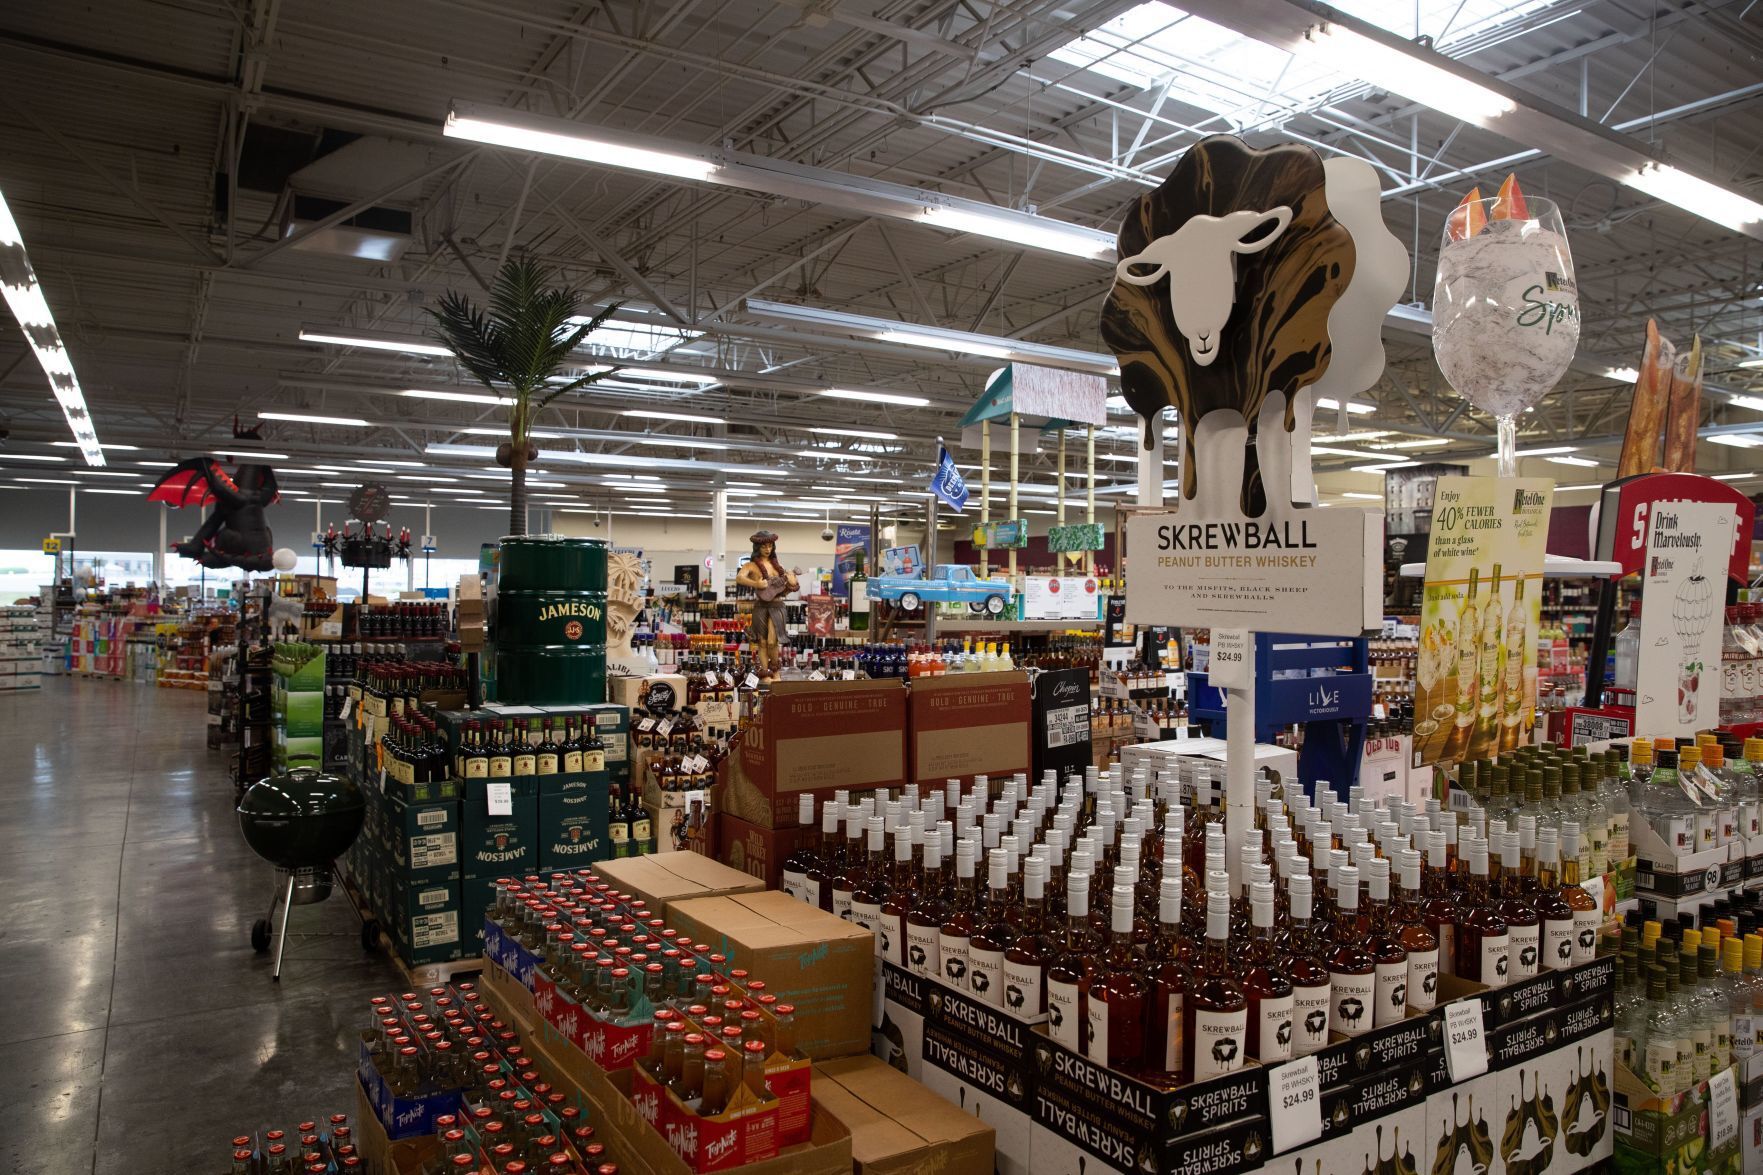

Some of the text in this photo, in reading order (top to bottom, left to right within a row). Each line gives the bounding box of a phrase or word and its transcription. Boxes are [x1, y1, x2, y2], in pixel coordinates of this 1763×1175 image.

[1440, 491, 1460, 502] Enjoy
[1437, 506, 1494, 530] 40% FEWER
[1464, 519, 1502, 530] CALORIES
[1655, 511, 1679, 530] Drink
[1157, 520, 1317, 550] SKREWBALL
[1435, 536, 1451, 545] than
[1457, 536, 1474, 546] glass
[1653, 531, 1702, 553] Marvelously.
[45, 542, 58, 550] 12
[1433, 548, 1441, 558] of
[1442, 548, 1460, 557] white
[1157, 555, 1317, 567] PEANUT BUTTER WHISKEY
[538, 603, 601, 622] JAMESON
[1217, 652, 1242, 662] $24.99
[1053, 680, 1081, 697] Chopin
[1309, 684, 1339, 706] LIVE
[791, 698, 888, 713] BOLD GENUINE TRUE
[930, 692, 1015, 707] BOLD GENUINE TRUE
[745, 727, 765, 749] 101
[1366, 740, 1382, 756] OLD
[562, 781, 588, 791] JAMESON
[563, 795, 588, 804] JAMESON
[475, 846, 526, 862] JAMESON
[552, 838, 599, 854] JAMESON
[1706, 870, 1717, 884] 98
[1574, 962, 1614, 983] SKREWBALL
[1580, 974, 1607, 992] SPIRITS
[1513, 979, 1555, 1002] SKREWBALL
[1520, 993, 1549, 1011] SPIRITS
[944, 995, 1023, 1048] SKREWBALL
[1561, 1014, 1600, 1038] SKREWBALL
[1567, 1006, 1594, 1025] SPIRITS
[611, 1034, 640, 1057] TopNote
[943, 1014, 1023, 1058] PEANUT BUTTER WHISKEY
[1373, 1027, 1427, 1053] SKREWBALL
[1452, 1029, 1478, 1045] $24.99
[1506, 1026, 1537, 1046] SPIRITS
[1382, 1042, 1418, 1063] SPIRITS
[1499, 1035, 1544, 1060] SKREWBALL
[925, 1037, 1005, 1093] SKREWBALL
[1281, 1066, 1308, 1080] Skrewball
[1054, 1052, 1157, 1119] SKREWBALL
[1190, 1081, 1259, 1110] SKREWBALL
[1282, 1082, 1290, 1091] PB
[1362, 1078, 1399, 1099] SPIRITS
[1054, 1073, 1156, 1131] PEANUT BUTTER WHISKEY
[1202, 1097, 1247, 1121] SPIRITS
[1283, 1089, 1314, 1108] $24.99
[1353, 1087, 1407, 1115] SKREWBALL
[396, 1102, 425, 1128] TopNote
[666, 1123, 698, 1159] TopNote
[1037, 1096, 1135, 1168] SKREWBALL
[1103, 1122, 1135, 1144] PEANUT
[705, 1129, 738, 1159] TopNote
[1183, 1139, 1230, 1165] SPIRITS
